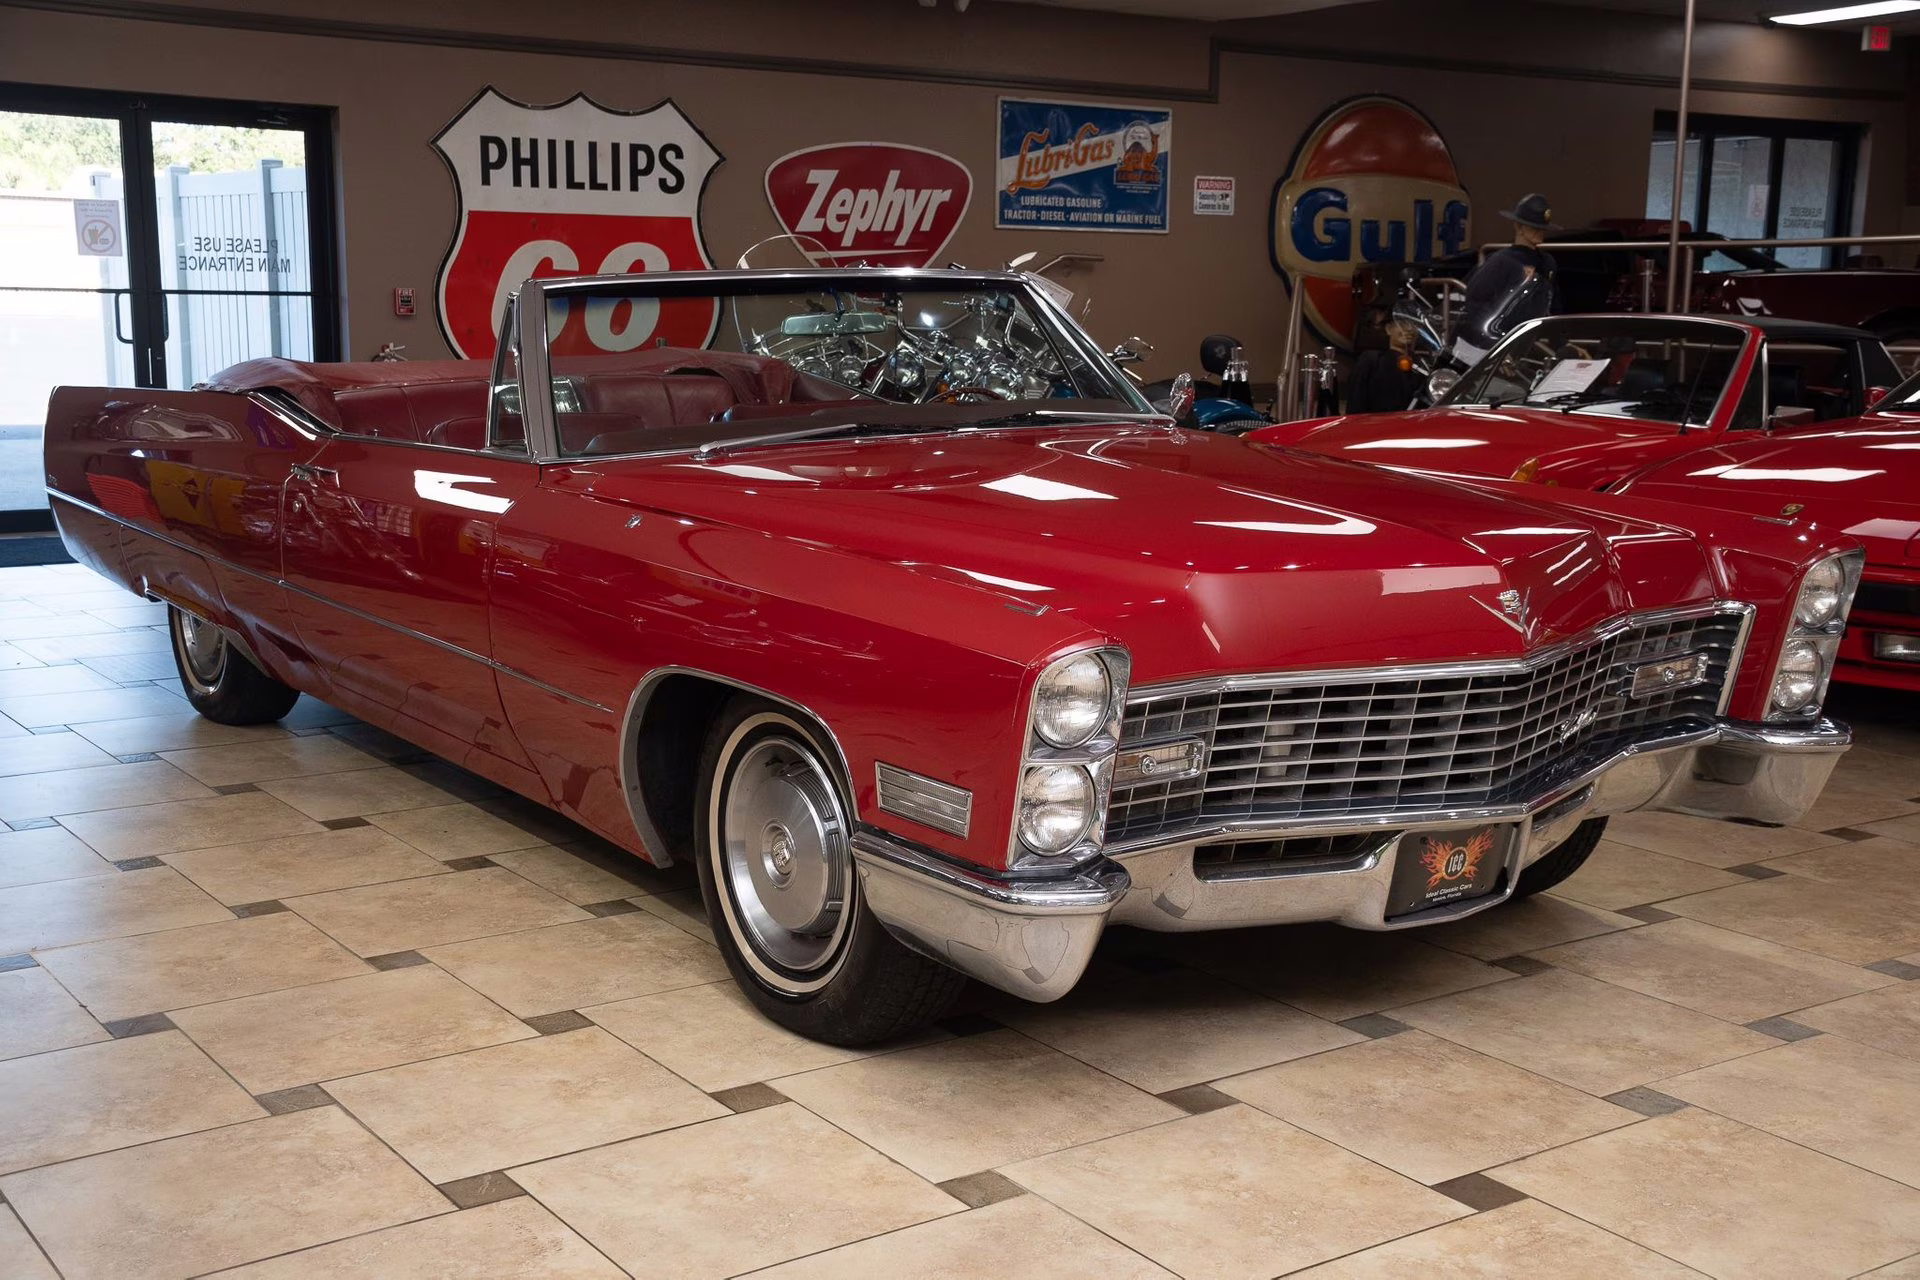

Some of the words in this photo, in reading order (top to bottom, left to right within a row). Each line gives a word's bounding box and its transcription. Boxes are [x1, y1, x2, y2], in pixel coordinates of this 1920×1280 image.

[479, 134, 685, 195] PHILLIPS
[1198, 180, 1232, 190] WARNING
[795, 168, 952, 247] Zephyr
[1004, 210, 1038, 220] TRACTOR
[1070, 212, 1103, 223] AVIATION
[1104, 213, 1114, 223] OR
[1116, 214, 1143, 224] MARINE
[1145, 214, 1162, 225] FUEL
[1021, 196, 1065, 207] LUBRICATED
[1066, 197, 1102, 208] GASOLINE
[1291, 187, 1469, 263] Gulf
[491, 239, 671, 353] 66
